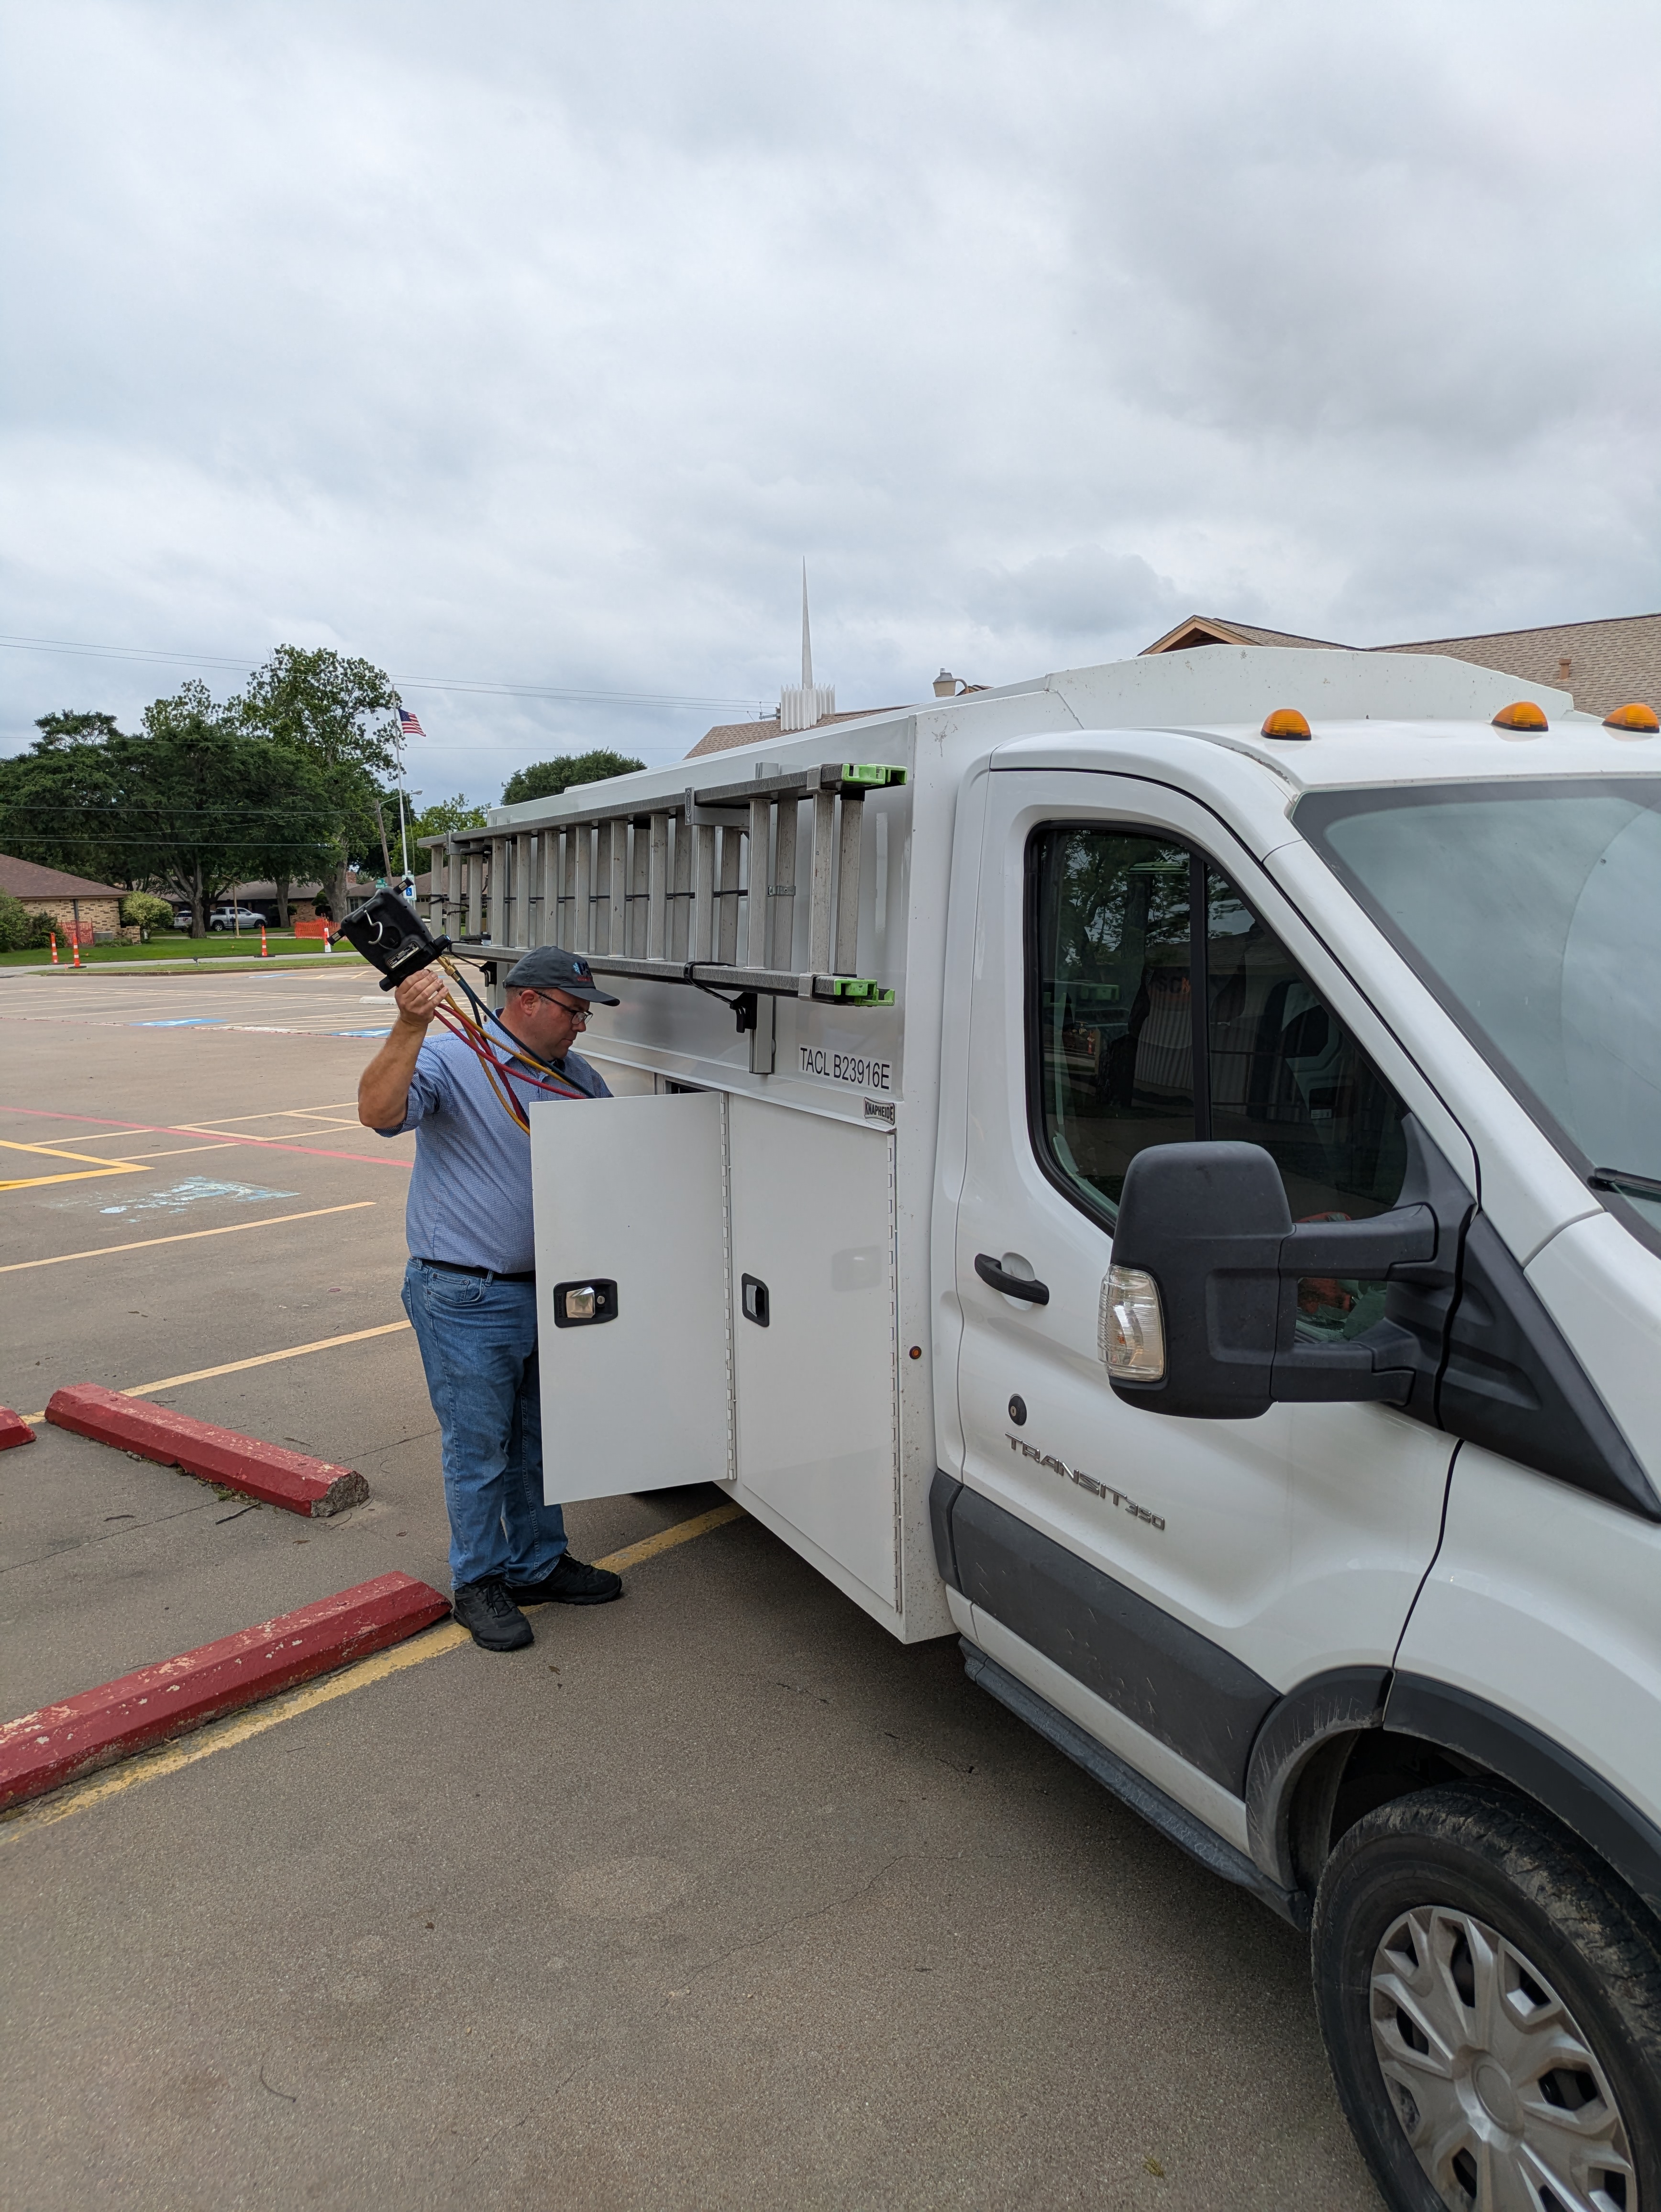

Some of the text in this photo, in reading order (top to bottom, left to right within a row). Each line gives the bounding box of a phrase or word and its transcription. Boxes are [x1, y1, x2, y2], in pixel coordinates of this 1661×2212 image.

[800, 1047, 890, 1090] TACL B23916E
[864, 1100, 893, 1122] KNAPHEIDE
[1005, 1432, 1165, 1530] TRANSIT 350
